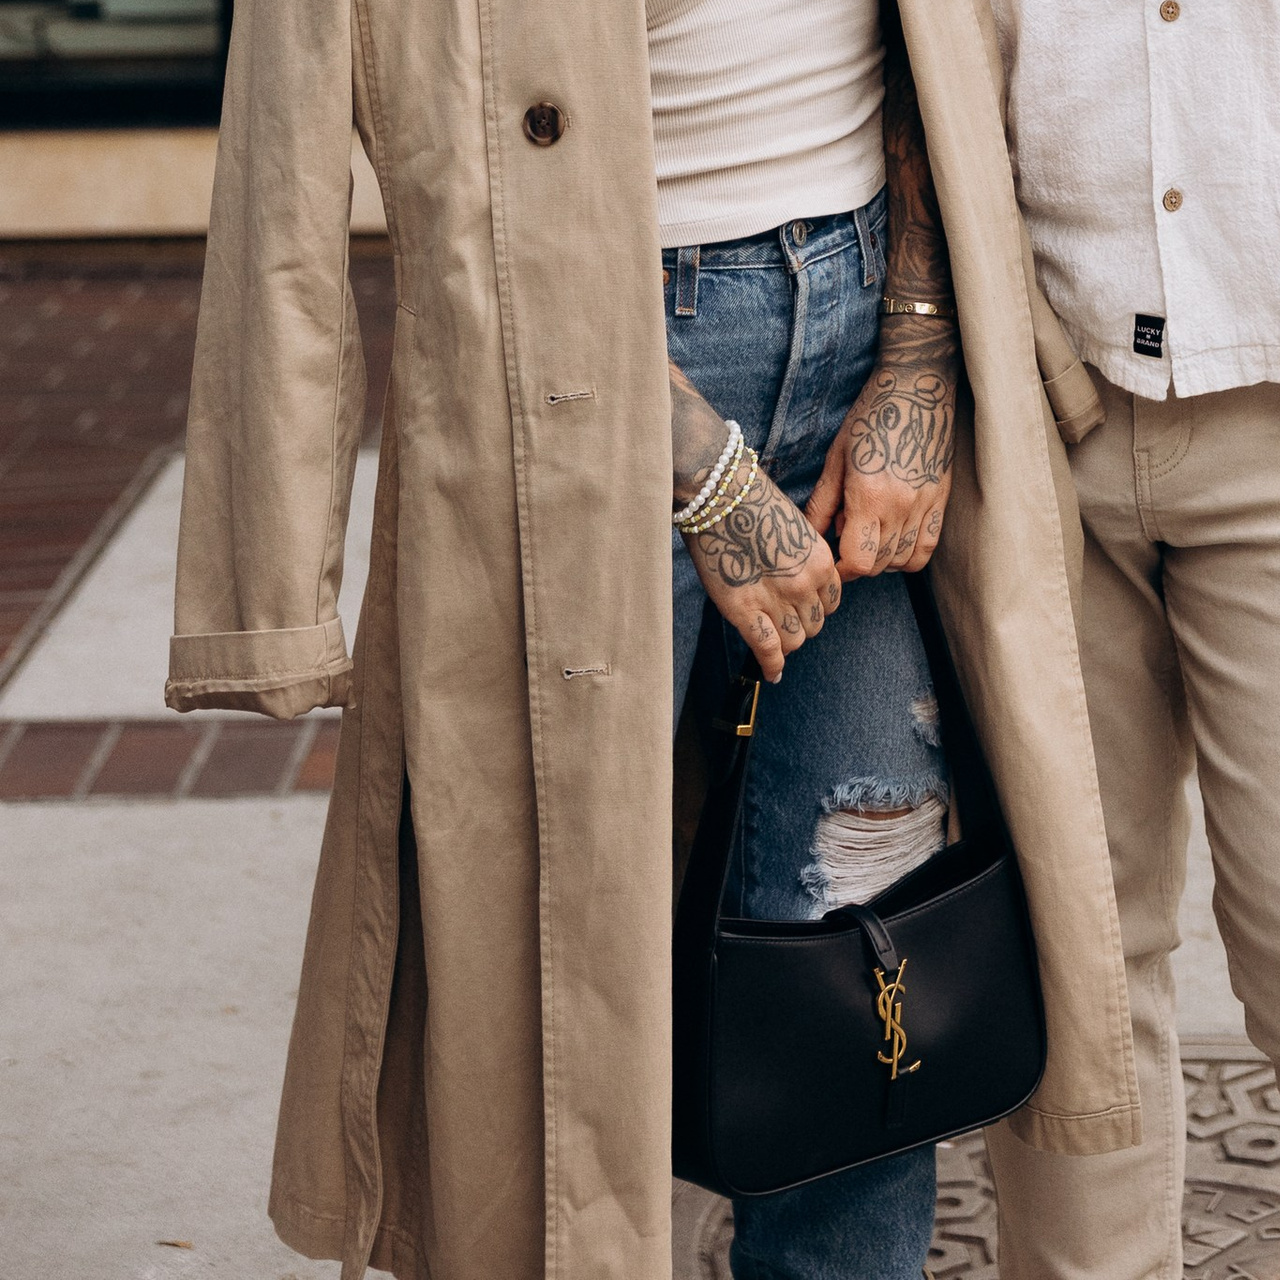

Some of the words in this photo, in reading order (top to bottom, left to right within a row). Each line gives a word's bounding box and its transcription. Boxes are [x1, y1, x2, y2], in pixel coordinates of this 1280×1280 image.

[1137, 325, 1161, 336] LUCKY
[1136, 338, 1160, 348] BRAND
[874, 958, 922, 1081] YSL
